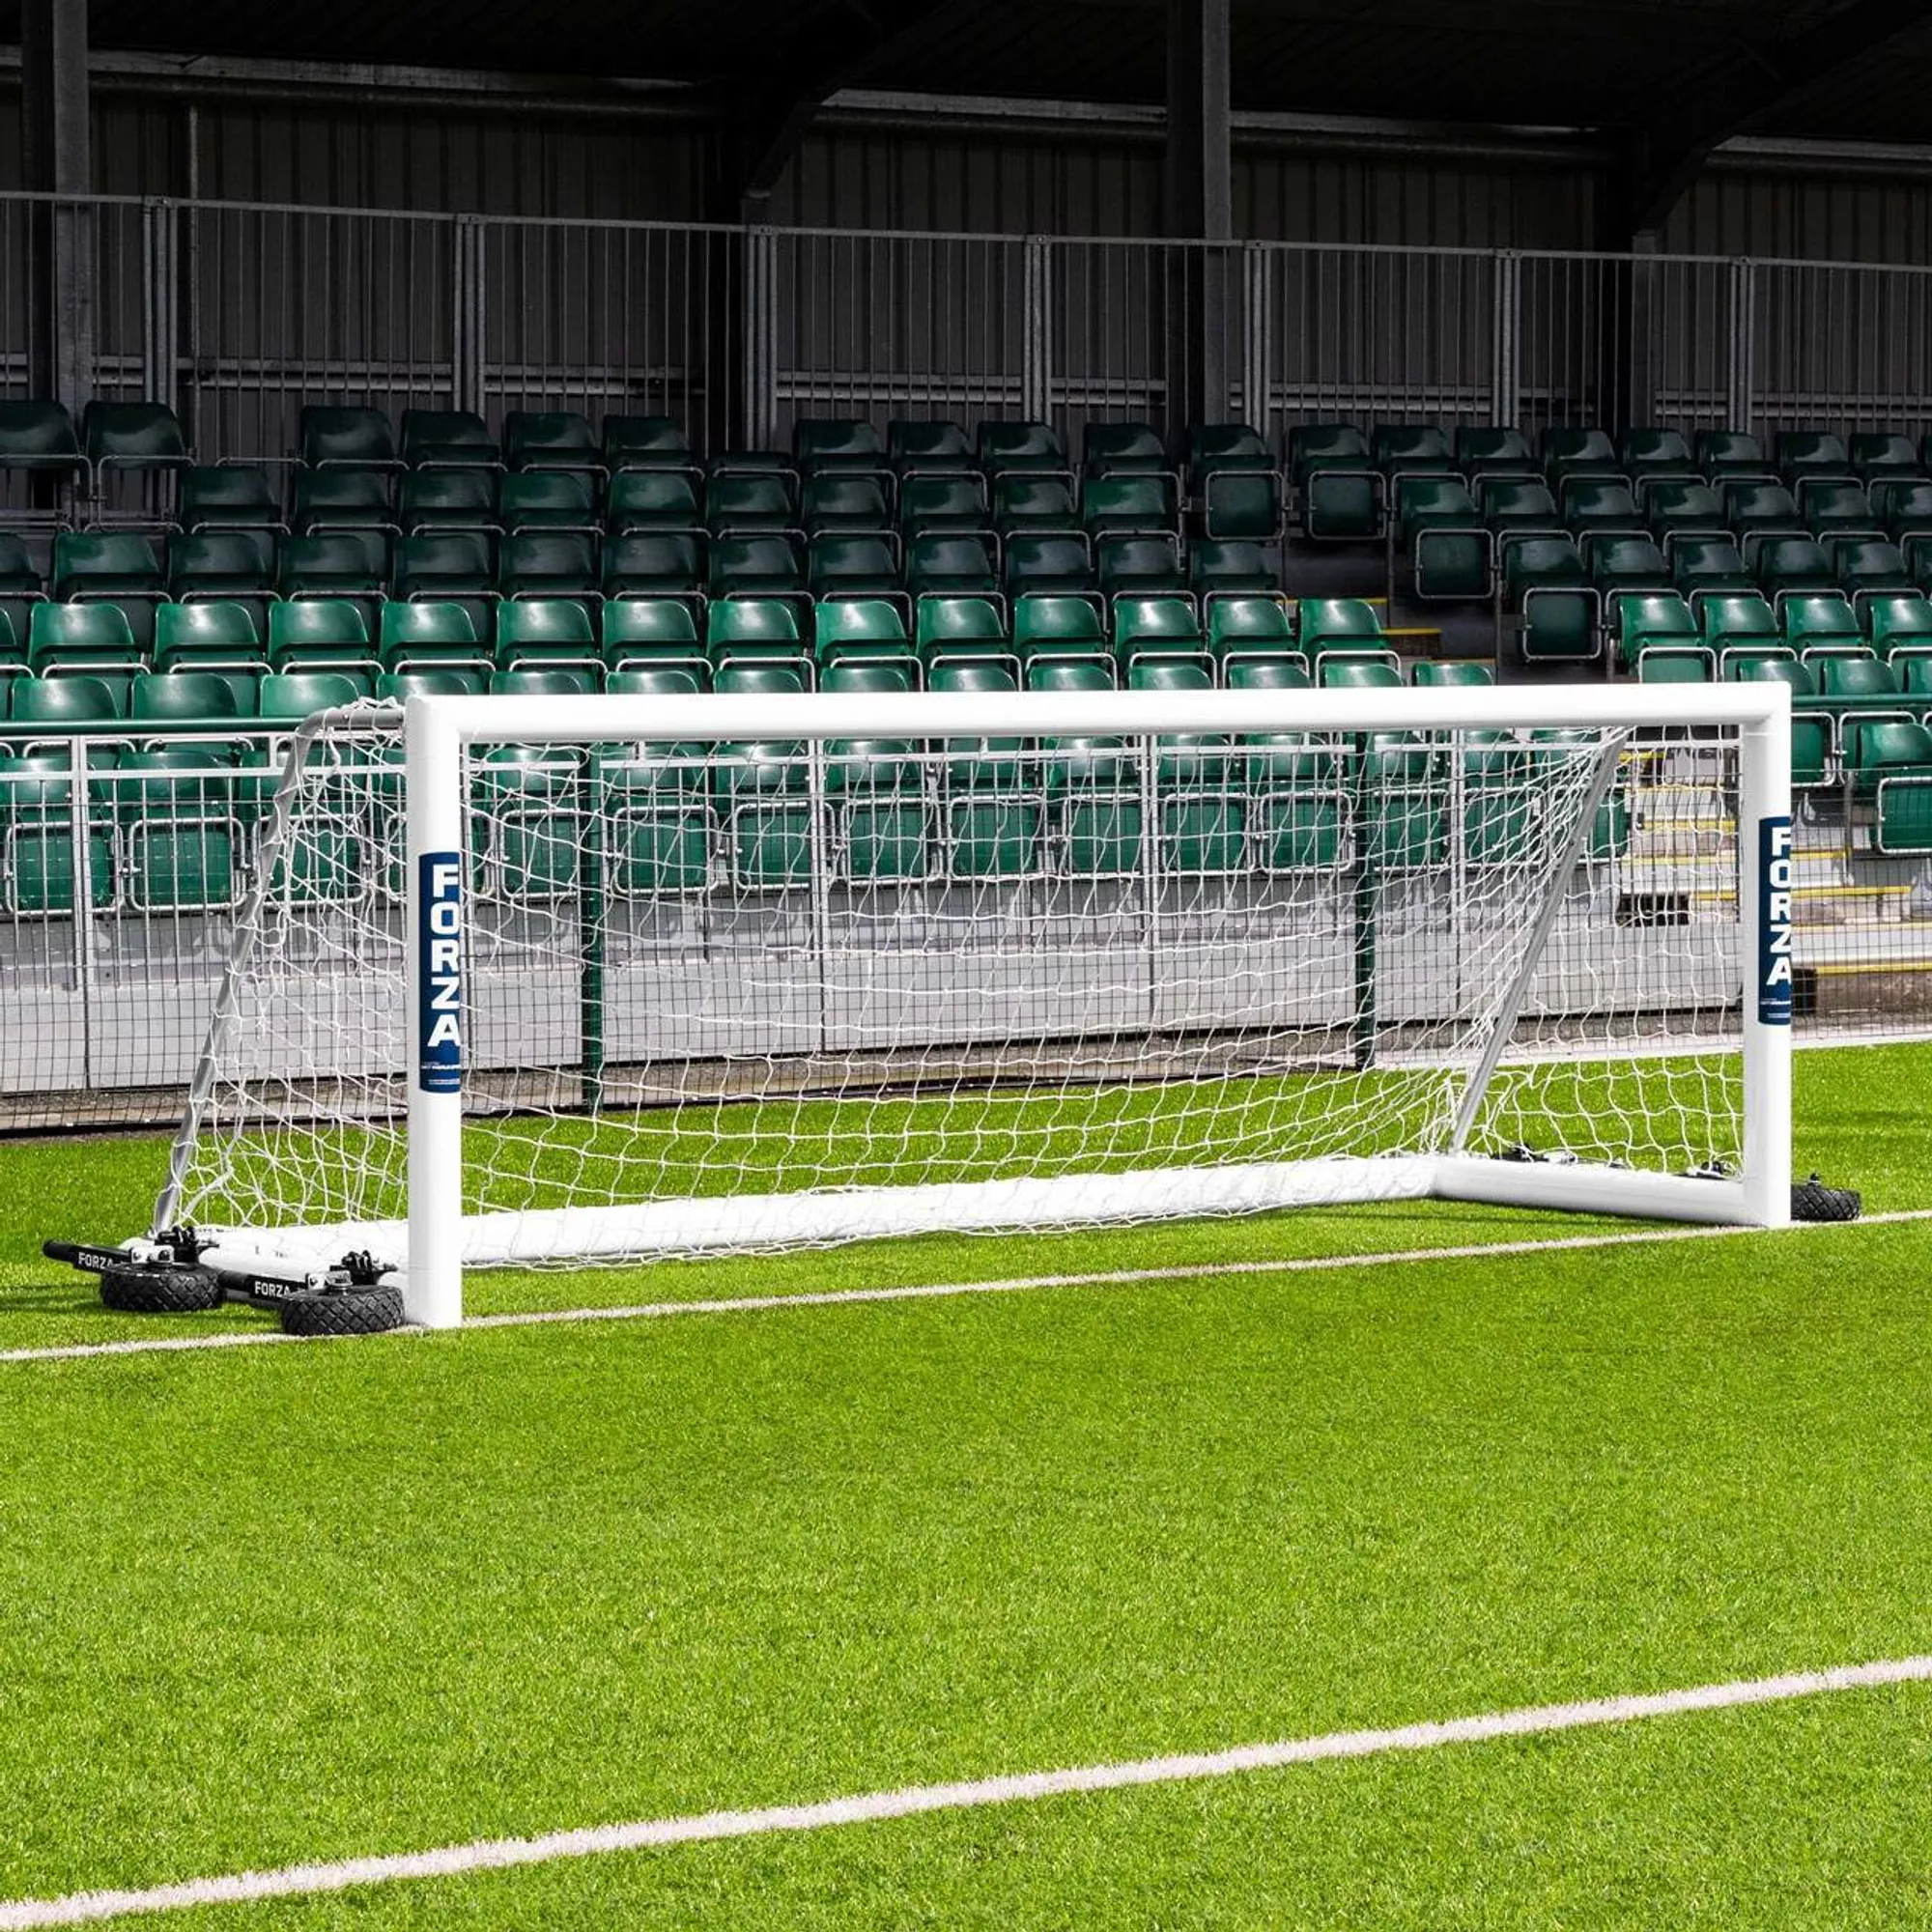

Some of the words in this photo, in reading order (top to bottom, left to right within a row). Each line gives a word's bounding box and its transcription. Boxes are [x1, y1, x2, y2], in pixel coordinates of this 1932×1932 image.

[1766, 827, 1791, 985] FORZA
[427, 864, 462, 1047] FORZA
[78, 1251, 113, 1269] FORZA
[255, 1281, 291, 1297] FORZA
